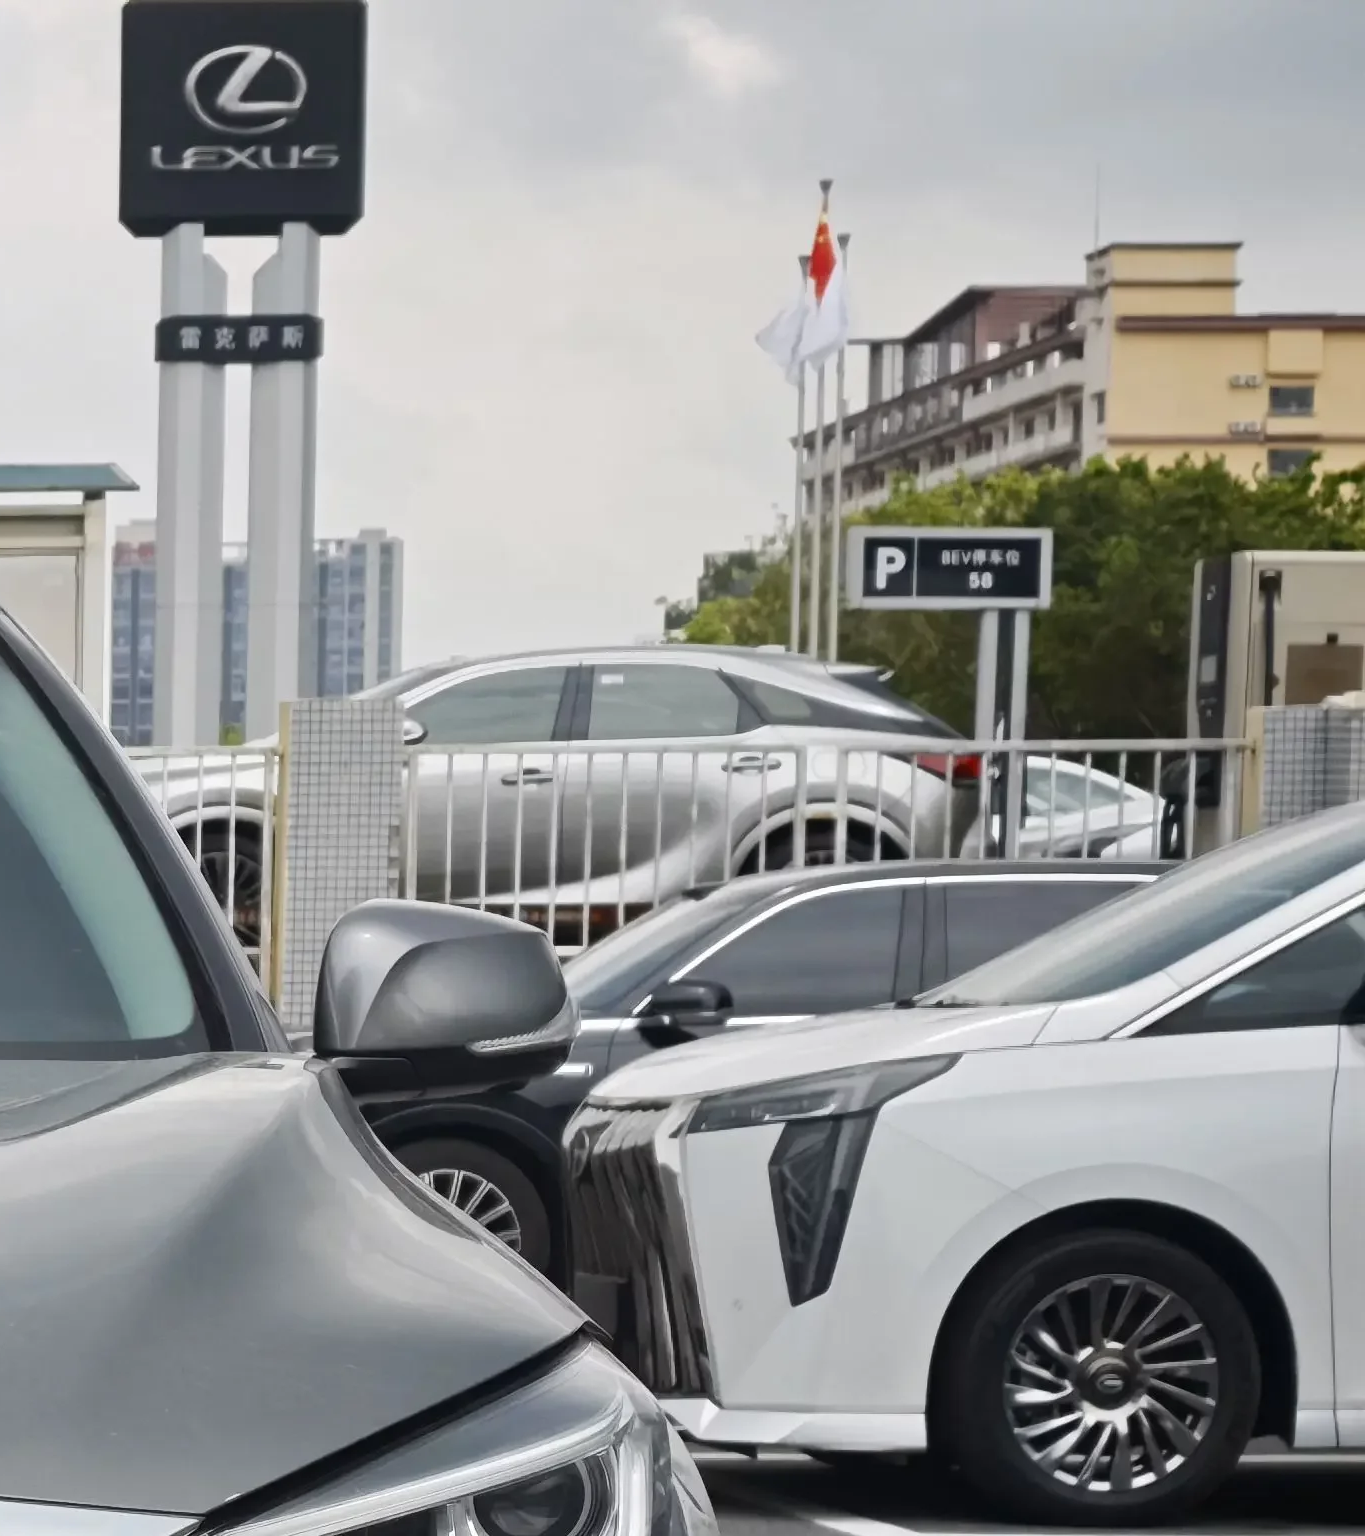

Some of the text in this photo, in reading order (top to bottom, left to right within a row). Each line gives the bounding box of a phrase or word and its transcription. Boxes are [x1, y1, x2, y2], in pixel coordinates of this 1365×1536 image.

[150, 145, 339, 170] LEXUS
[179, 325, 304, 350] 雷克萨斯
[875, 546, 906, 590] P
